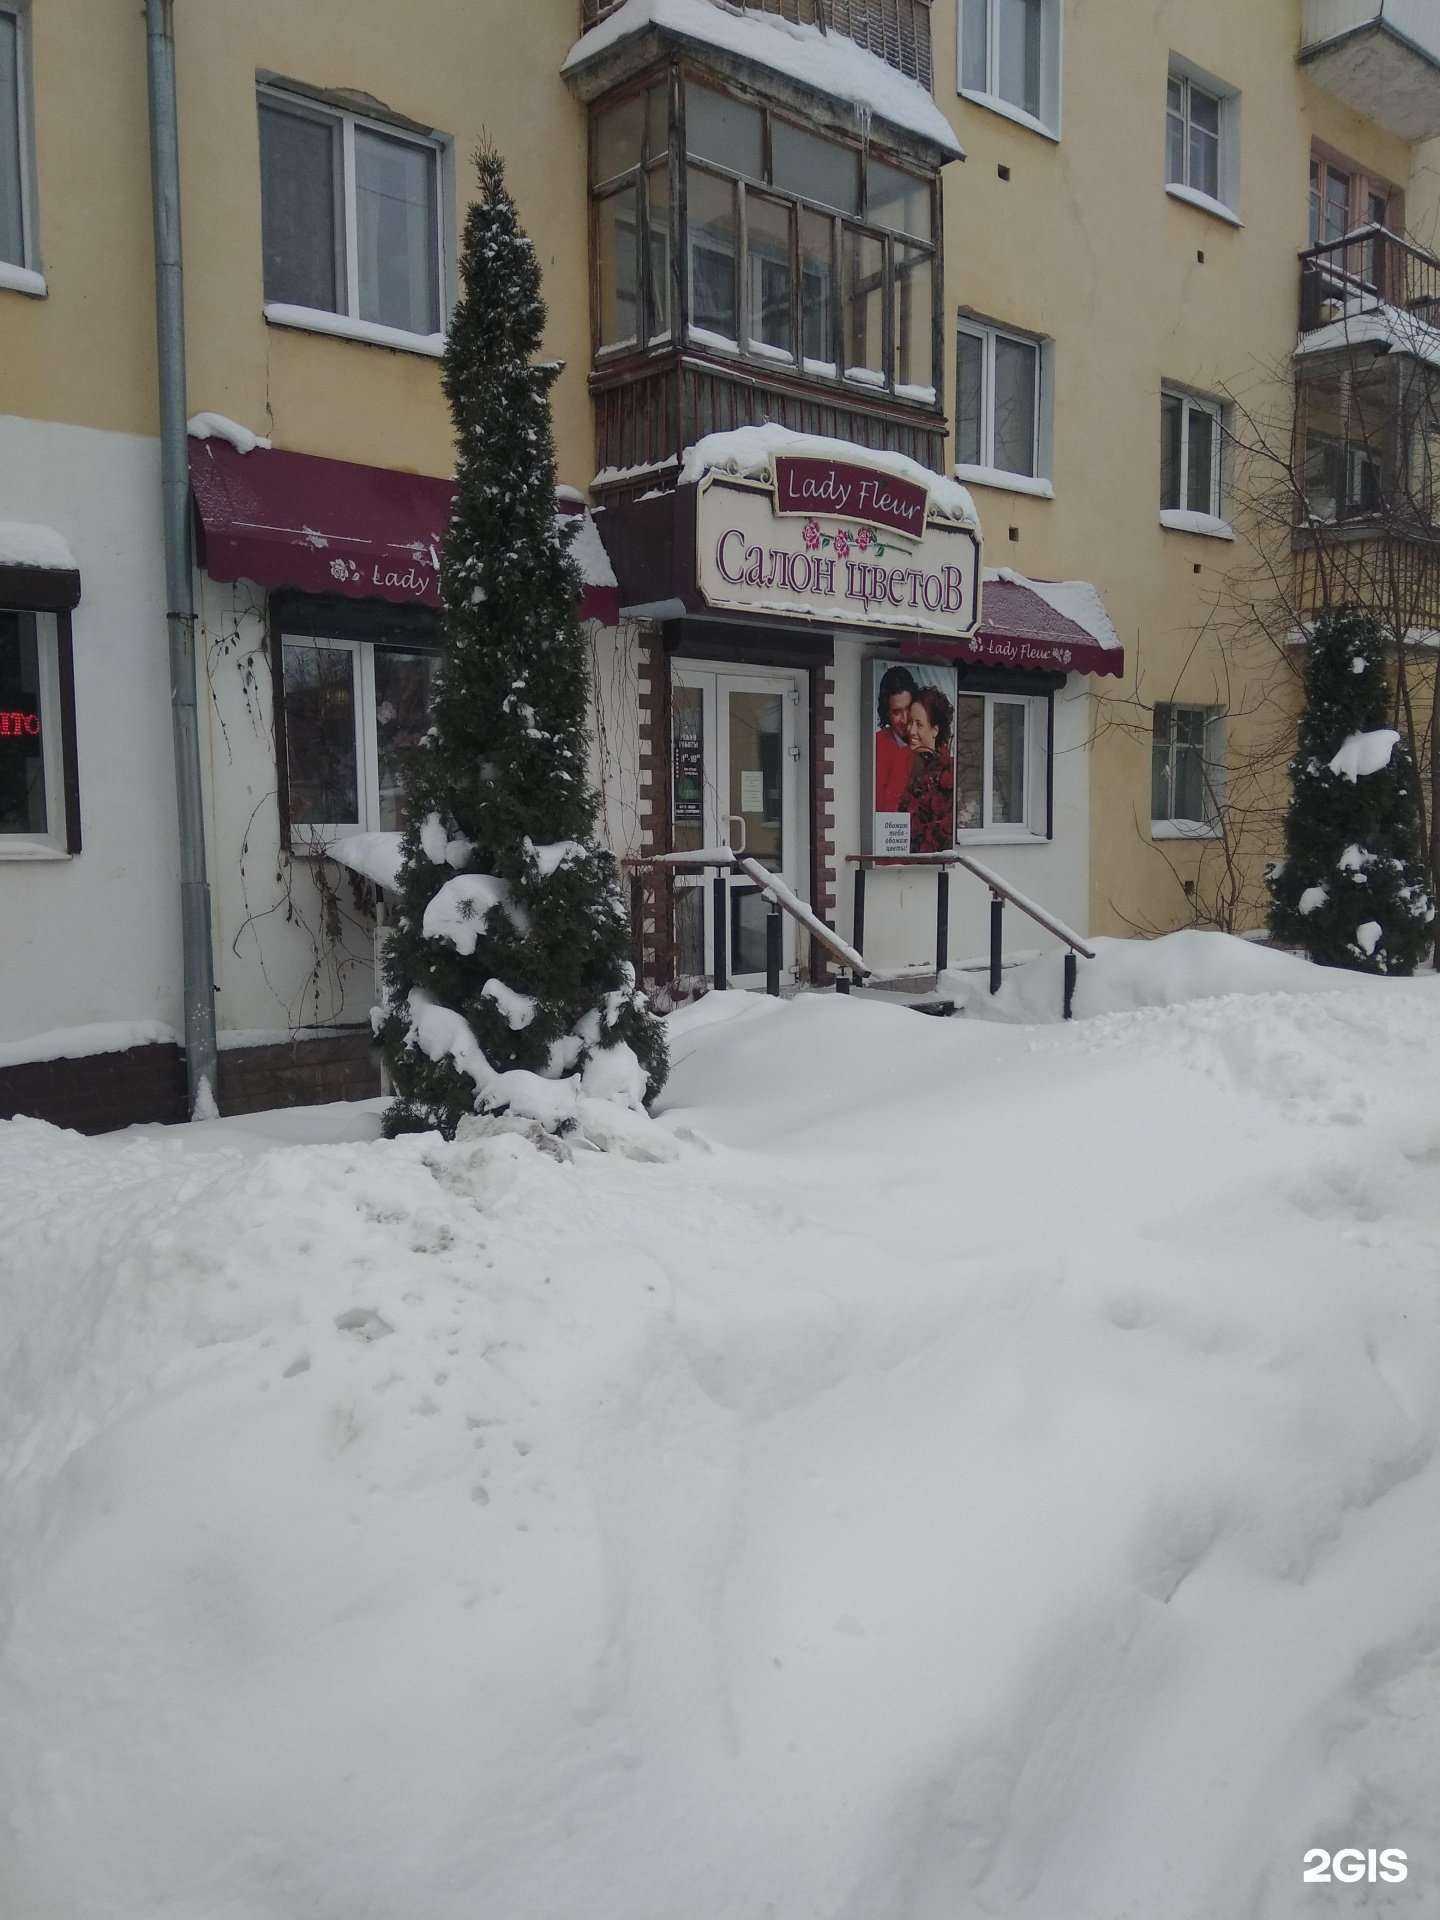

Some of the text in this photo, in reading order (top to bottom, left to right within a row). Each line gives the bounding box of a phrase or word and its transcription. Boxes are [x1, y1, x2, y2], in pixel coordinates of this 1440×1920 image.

[788, 468, 921, 520] Lady Fleur
[372, 564, 430, 596] Lady
[715, 528, 837, 596] Салон
[987, 639, 1051, 660] Lady Fleur
